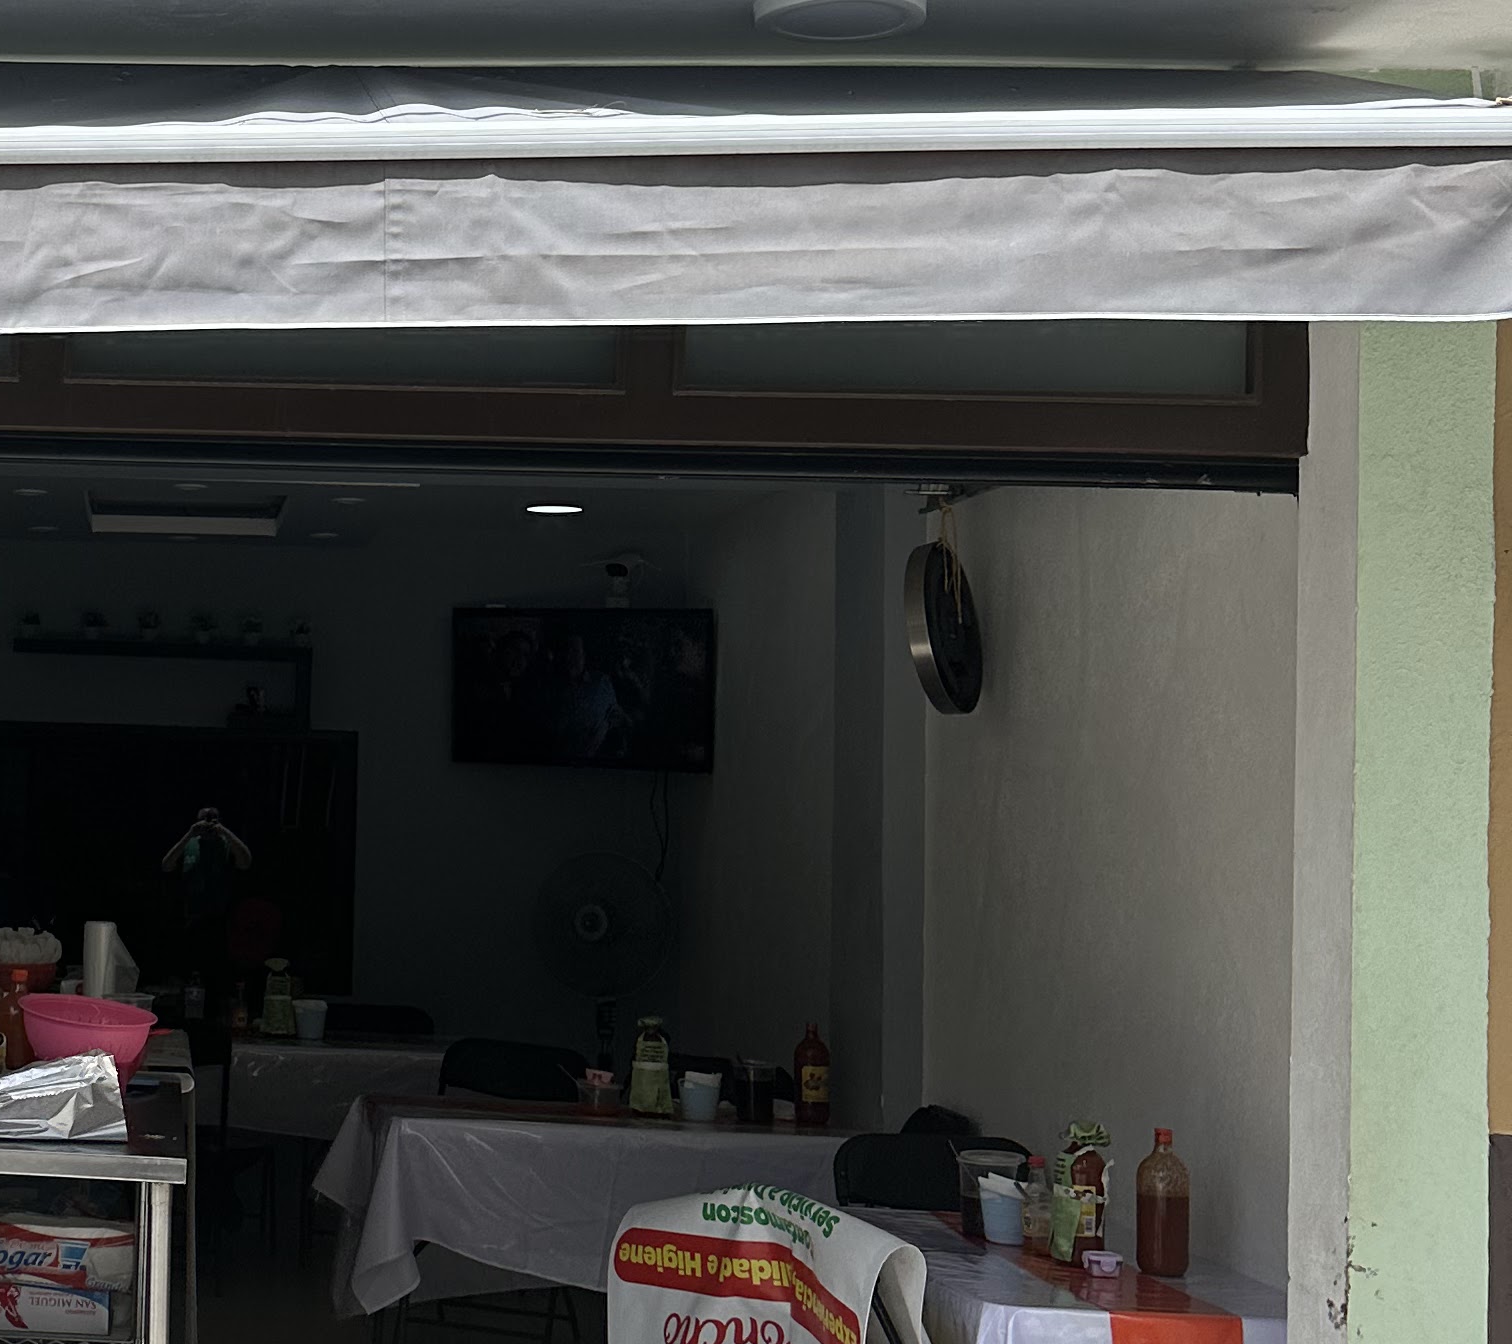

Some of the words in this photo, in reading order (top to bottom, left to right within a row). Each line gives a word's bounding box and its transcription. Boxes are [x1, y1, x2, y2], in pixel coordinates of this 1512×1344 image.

[740, 1206, 813, 1258] ontamos
[779, 1192, 841, 1239] Servicio
[619, 1242, 702, 1278] Higiene
[719, 1256, 792, 1287] lidad
[29, 1296, 73, 1308] MIGUEL
[77, 1299, 96, 1309] SAN
